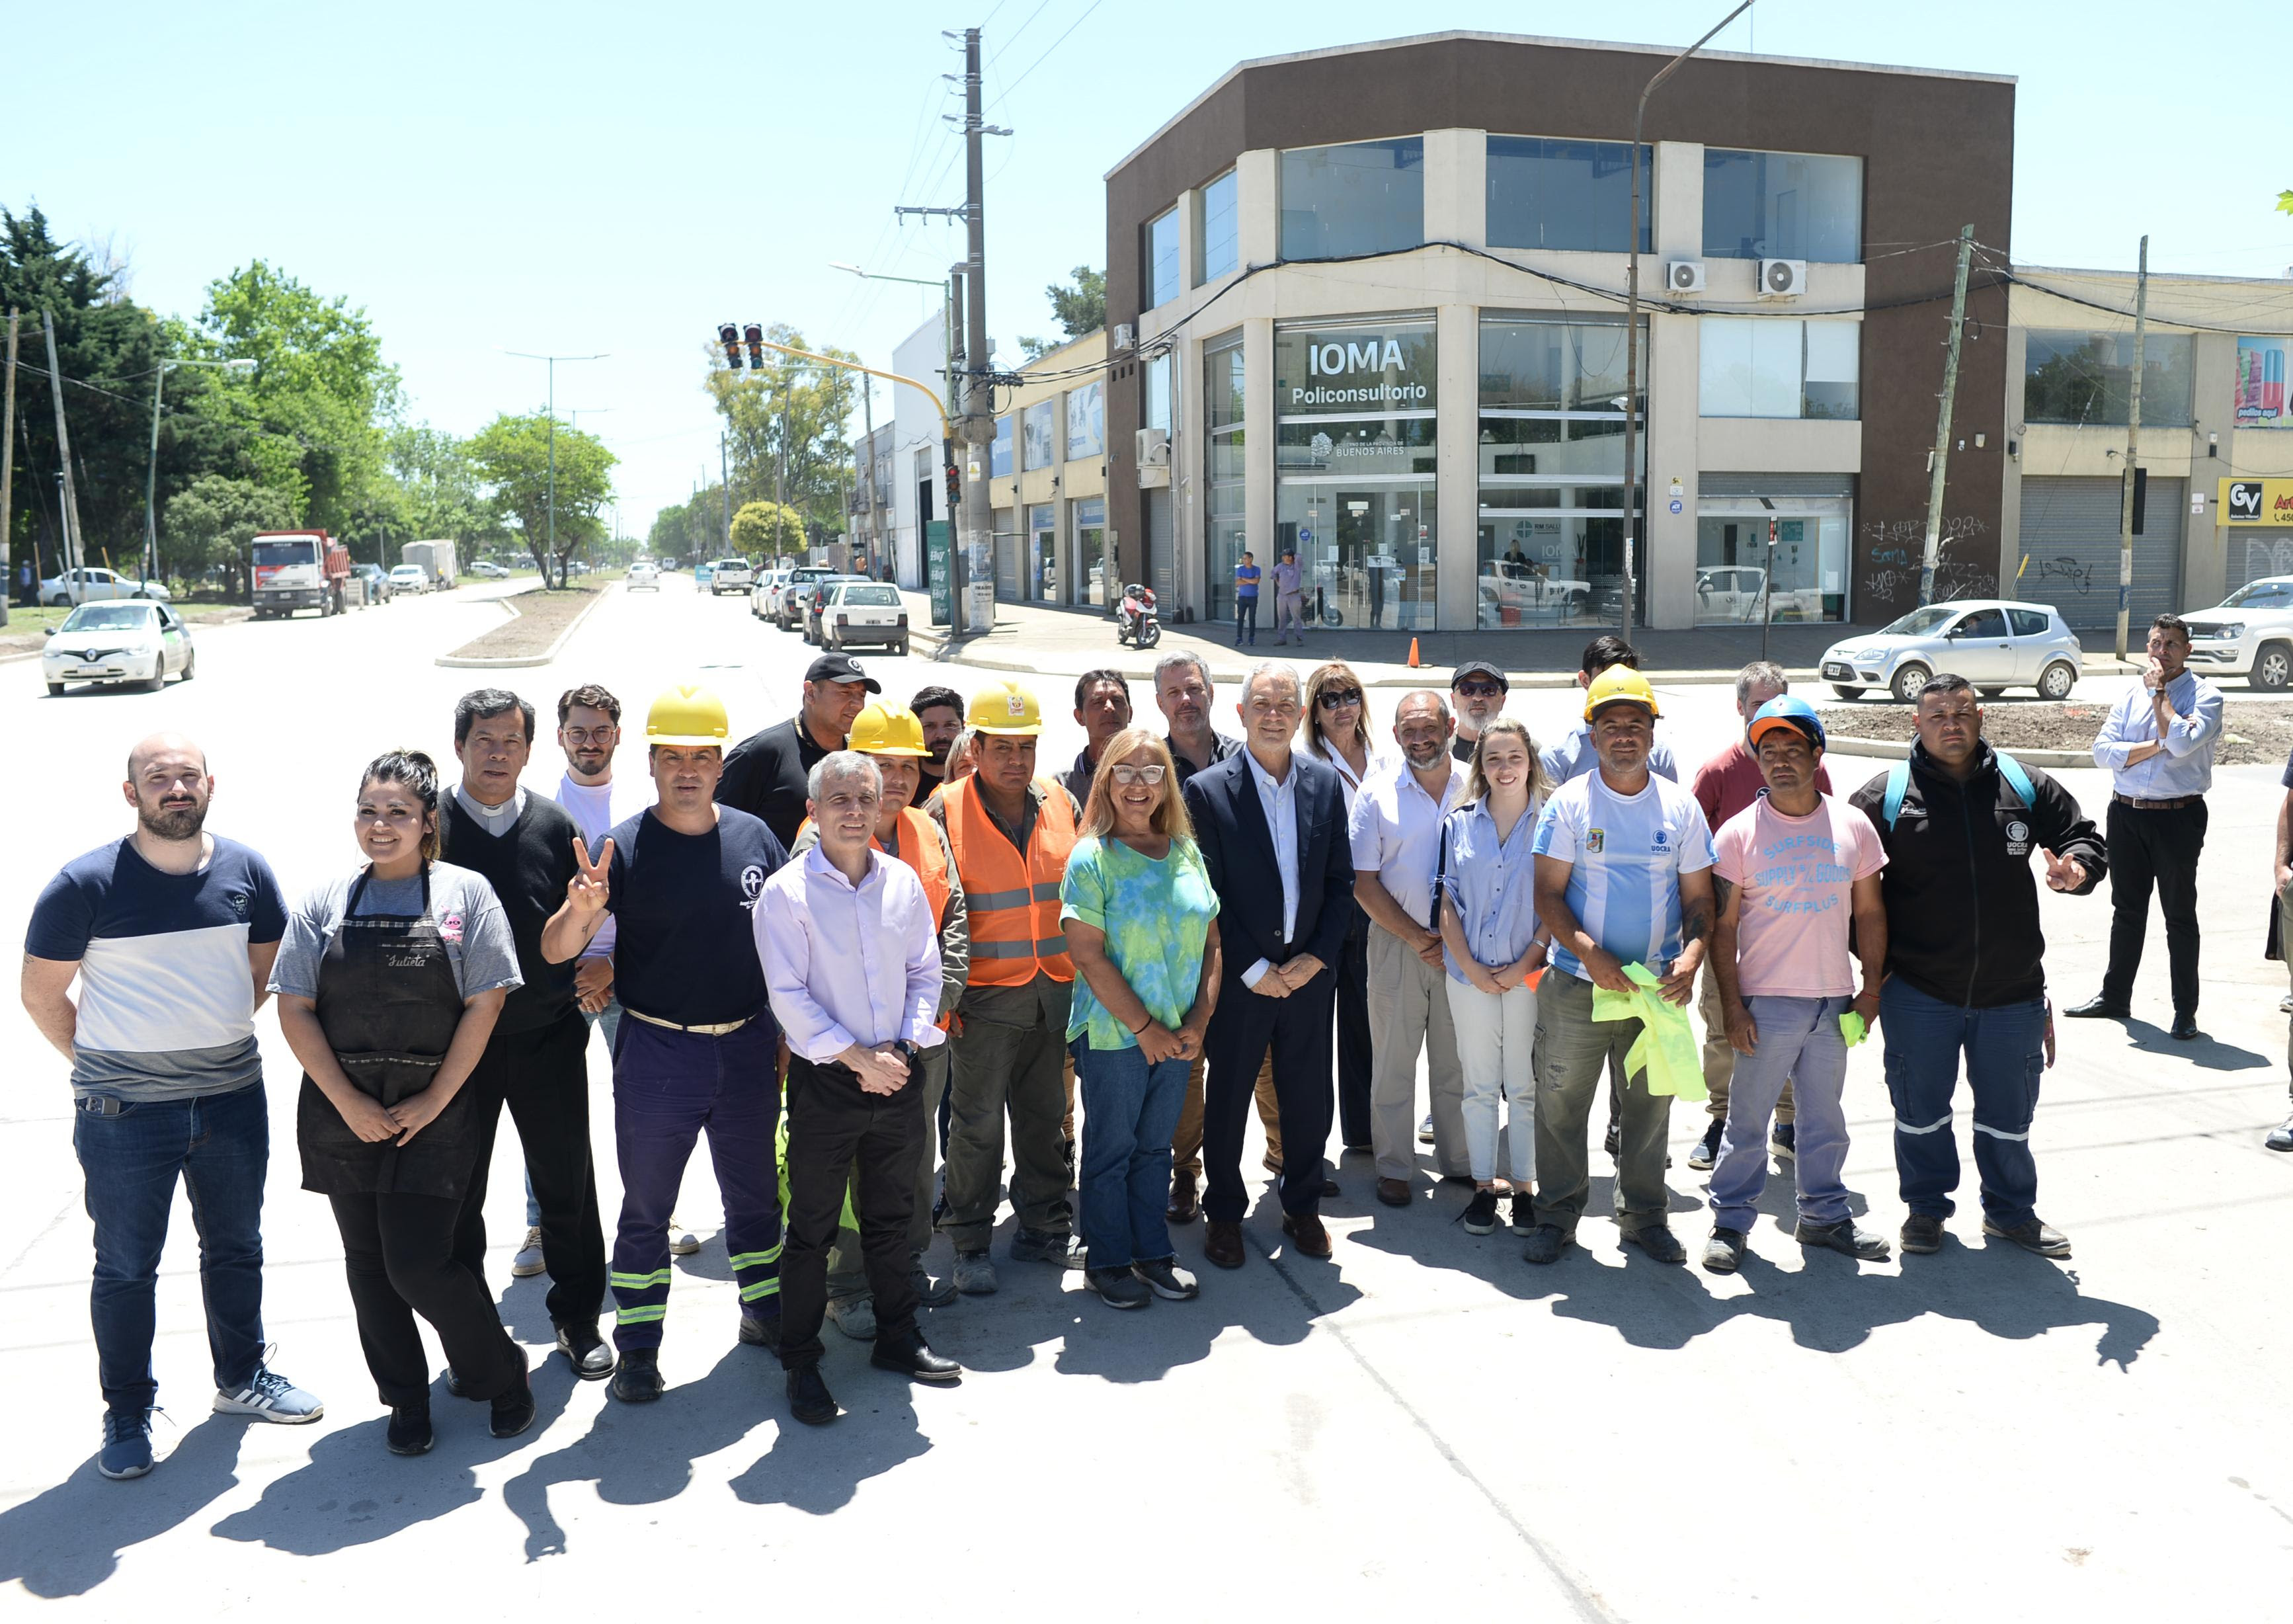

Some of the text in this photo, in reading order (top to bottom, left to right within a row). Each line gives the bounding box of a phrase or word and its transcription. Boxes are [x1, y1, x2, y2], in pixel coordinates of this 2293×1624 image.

[1310, 340, 1406, 376] IOMA
[1292, 382, 1427, 404] Policonsultorio
[1336, 446, 1404, 458] BUENOS AIRES
[1763, 836, 1841, 859] SURFSIDE
[1755, 866, 1796, 887] SUPPLY
[1766, 893, 1839, 914] SURFPLUS
